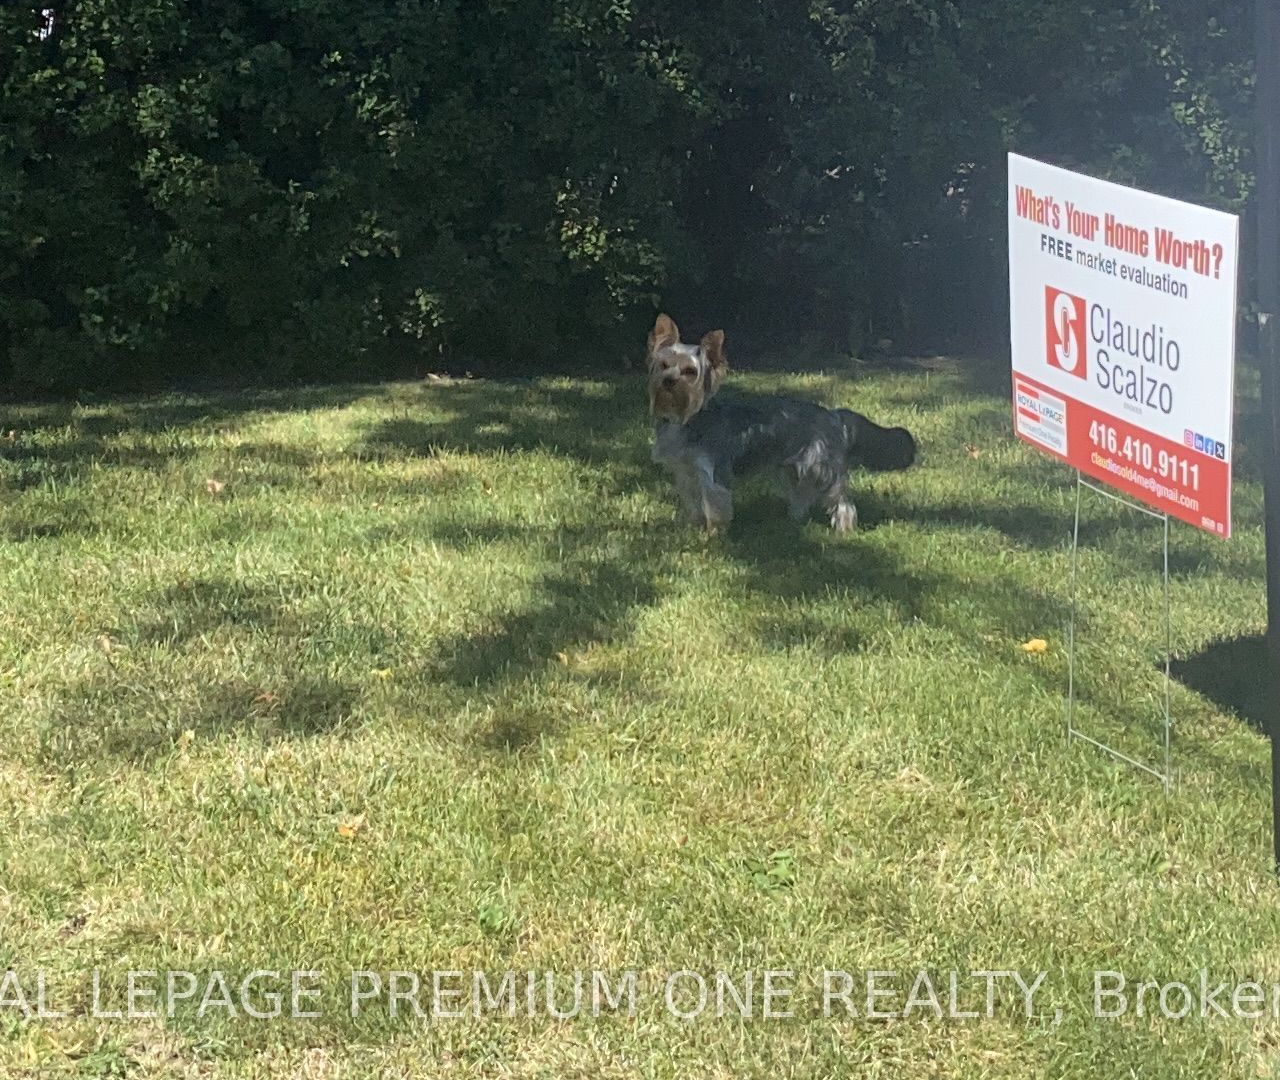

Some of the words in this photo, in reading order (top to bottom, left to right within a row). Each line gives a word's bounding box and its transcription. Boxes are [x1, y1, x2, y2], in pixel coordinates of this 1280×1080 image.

[1015, 184, 1061, 231] What's
[1064, 200, 1100, 242] Your
[1104, 212, 1149, 259] Home
[1154, 226, 1224, 280] Worth?
[1040, 233, 1073, 262] FREE
[1076, 247, 1118, 277] market
[1120, 263, 1189, 300] evaluation
[1090, 303, 1180, 372] Claudio
[1096, 348, 1173, 415] Scalzo
[1088, 420, 1200, 492] 416.410.9111
